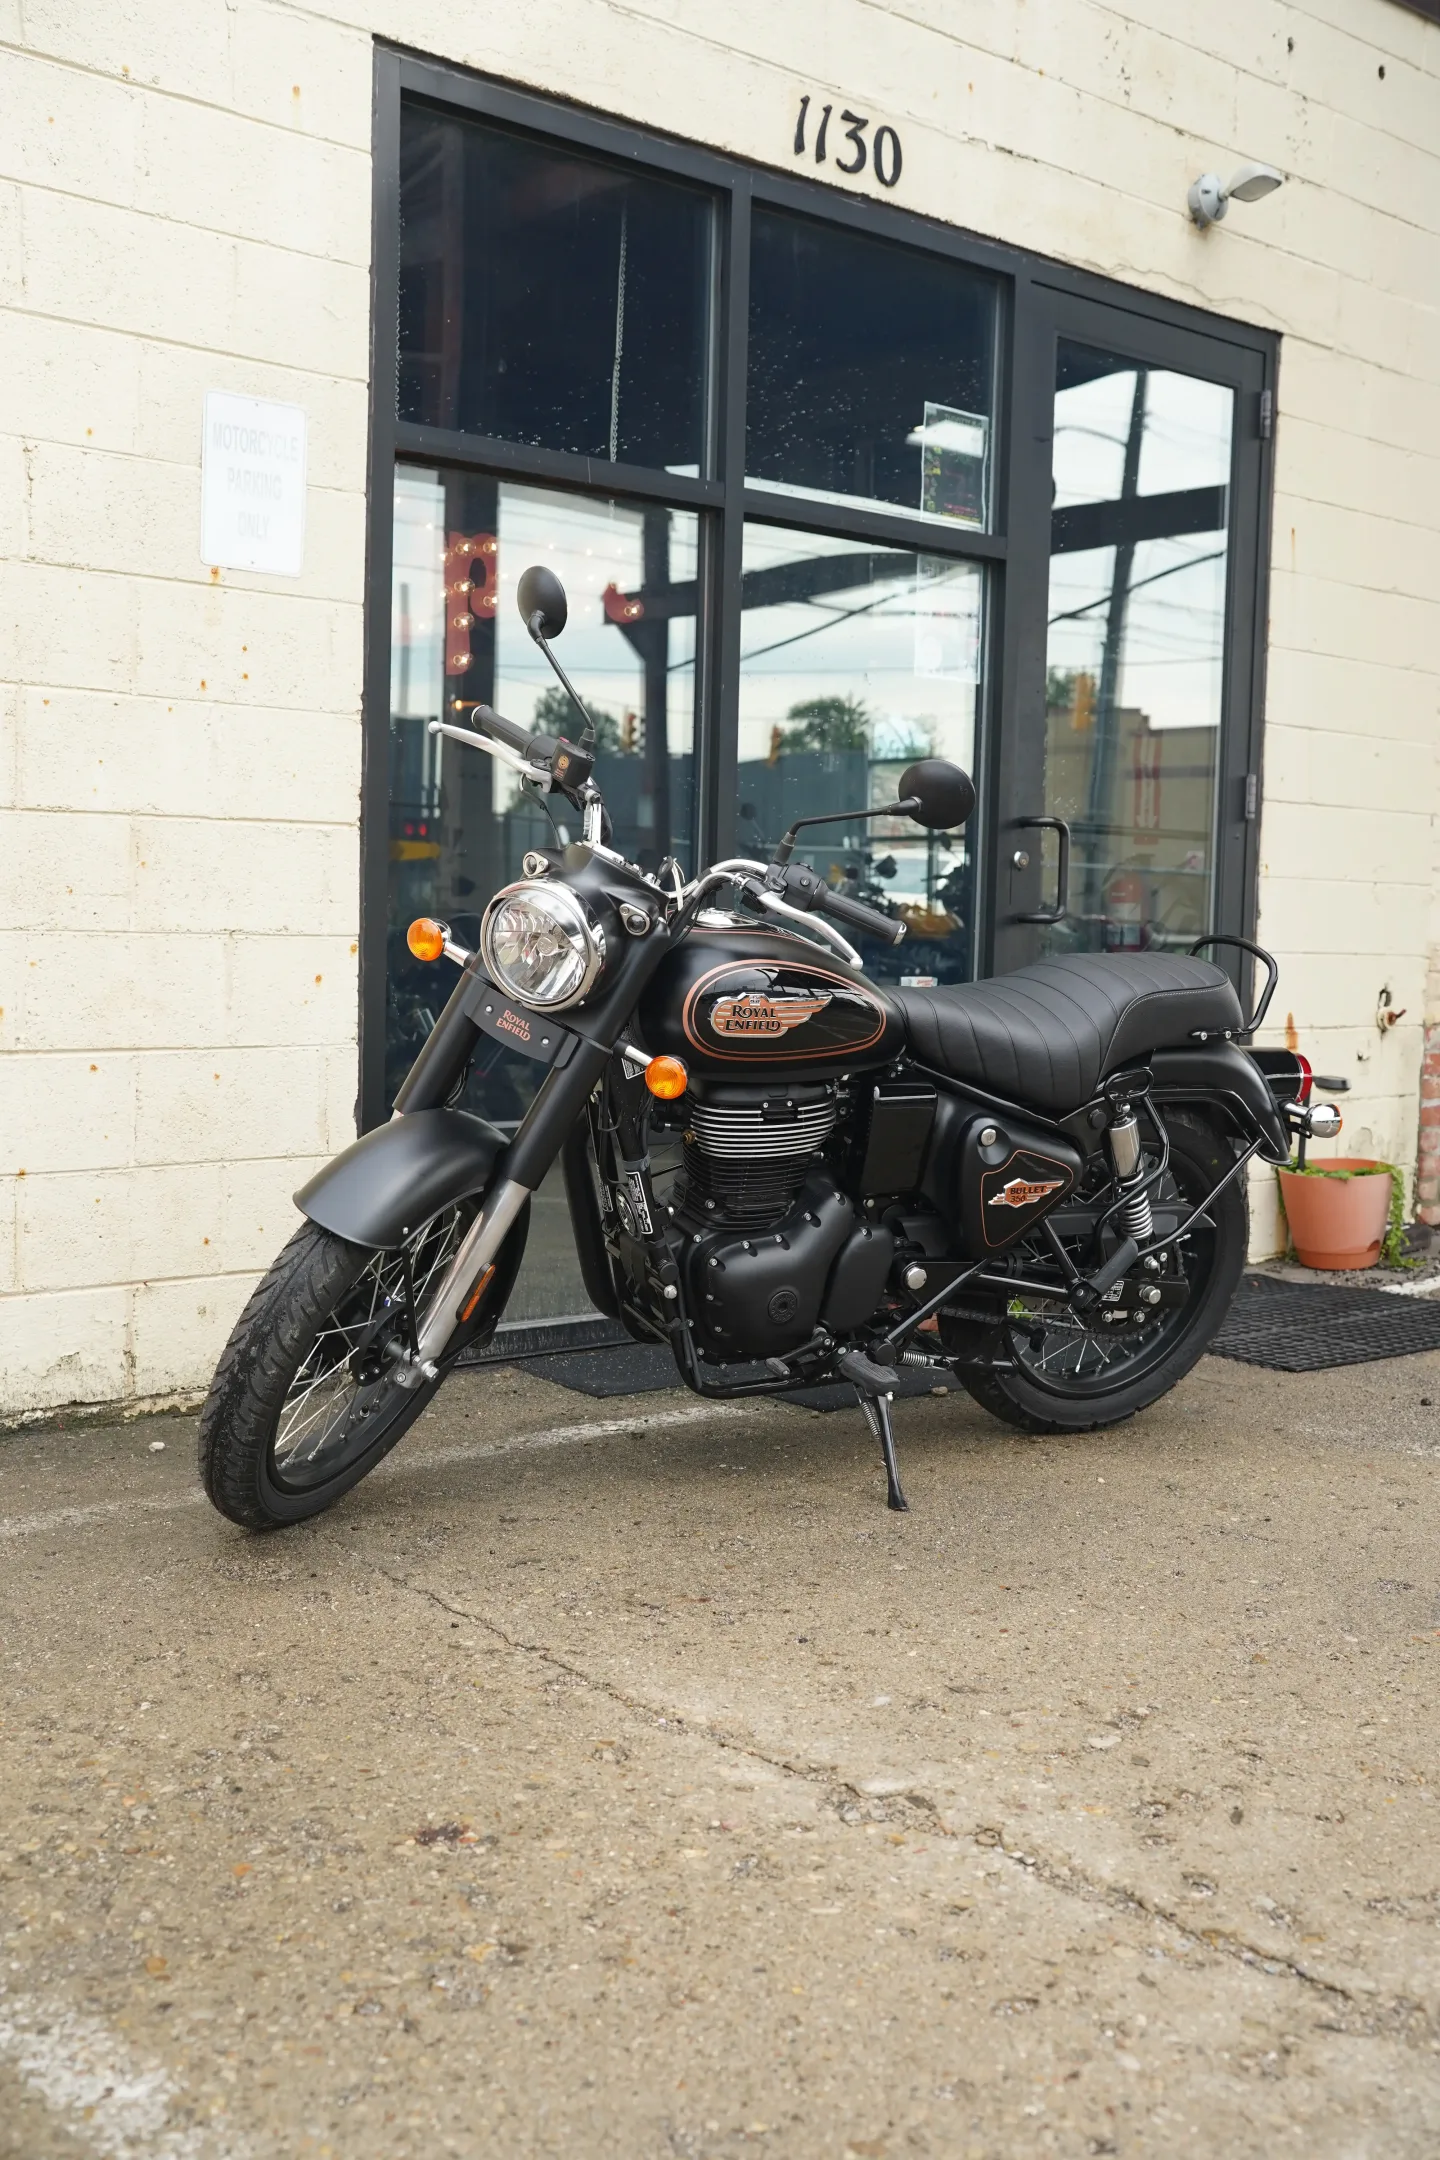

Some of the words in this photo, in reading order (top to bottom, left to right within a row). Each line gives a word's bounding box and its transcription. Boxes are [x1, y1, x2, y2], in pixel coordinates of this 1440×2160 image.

[794, 95, 902, 188] 1130
[212, 421, 299, 462] MOTORCYCLE
[227, 466, 283, 500] PARKING
[237, 511, 271, 540] ONLY
[502, 1009, 531, 1031] ROYAL
[732, 1004, 777, 1018] ROYAL
[496, 1017, 531, 1041] ENFIELD
[725, 1019, 781, 1032] ENFIELD
[1010, 1185, 1047, 1195] BULLET
[1010, 1194, 1026, 1203] 350
